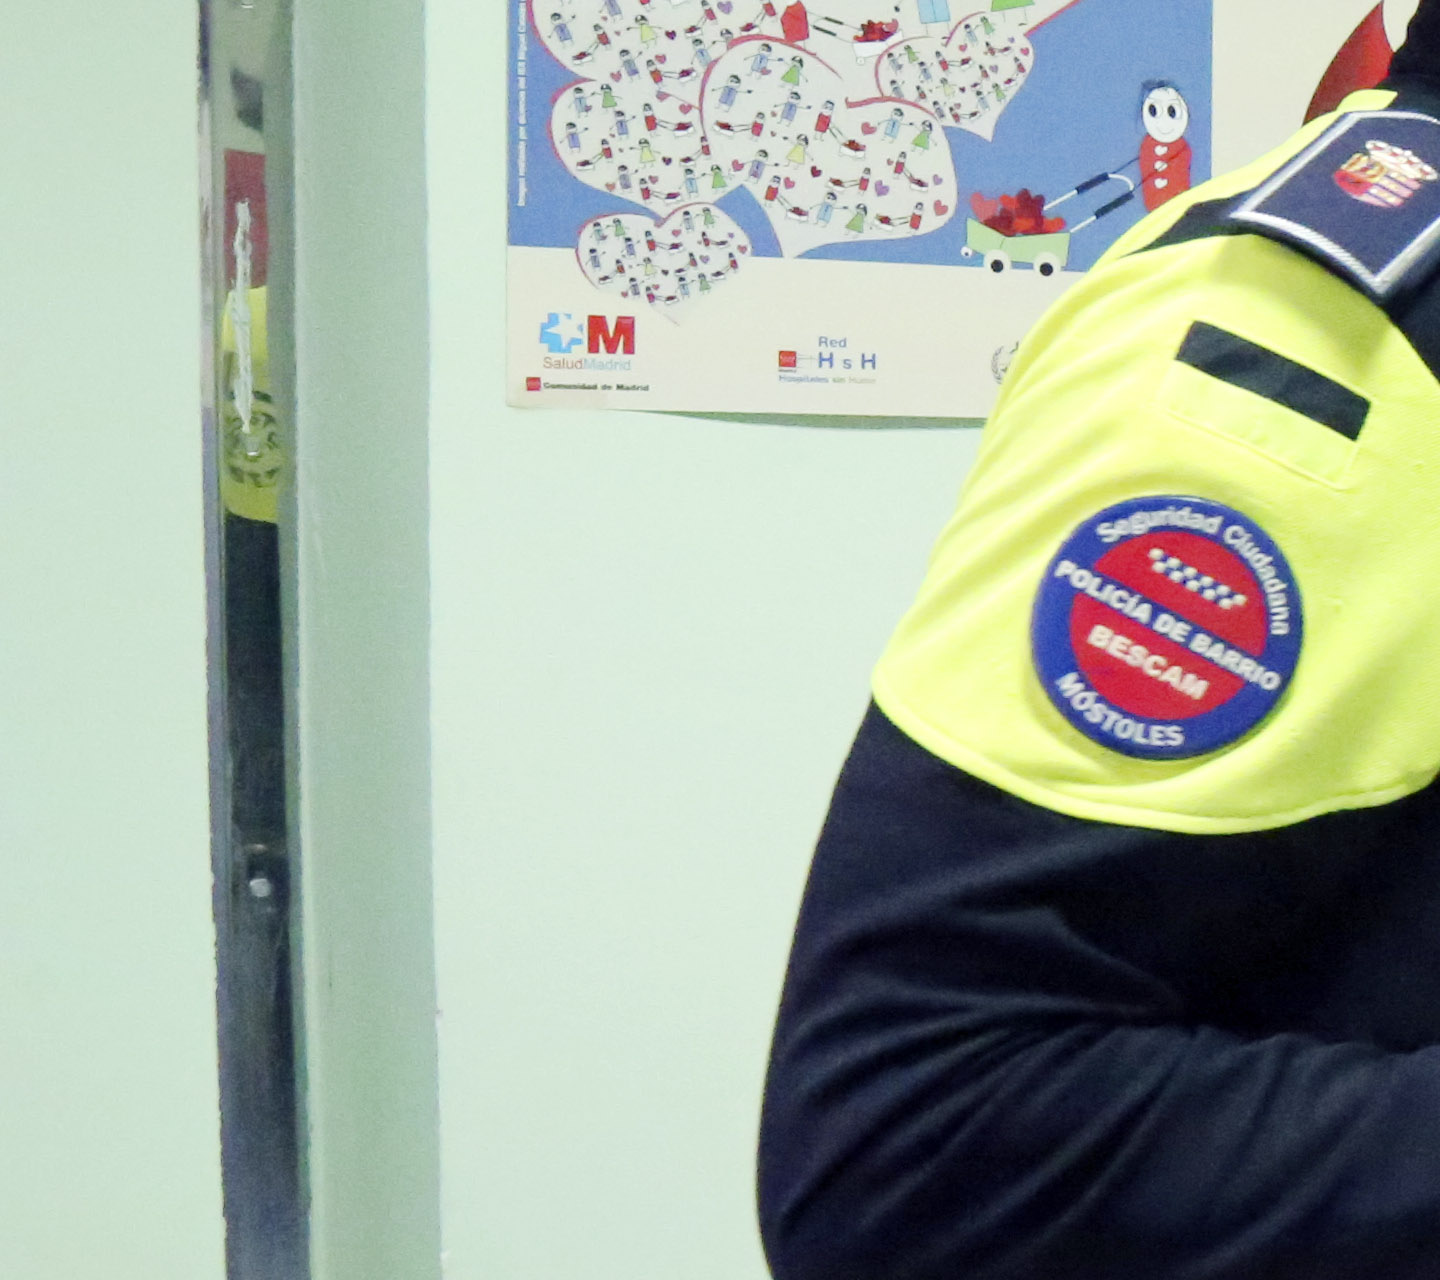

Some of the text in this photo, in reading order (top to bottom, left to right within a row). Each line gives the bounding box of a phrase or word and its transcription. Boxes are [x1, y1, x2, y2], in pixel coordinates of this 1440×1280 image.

[818, 336, 847, 349] Red
[1096, 506, 1290, 636] Seguridad Ciudadana
[1055, 559, 1282, 690] POLICÍA DE BARRIO
[1087, 624, 1210, 701] BESCAM
[1055, 671, 1185, 747] MÓSTOLES
